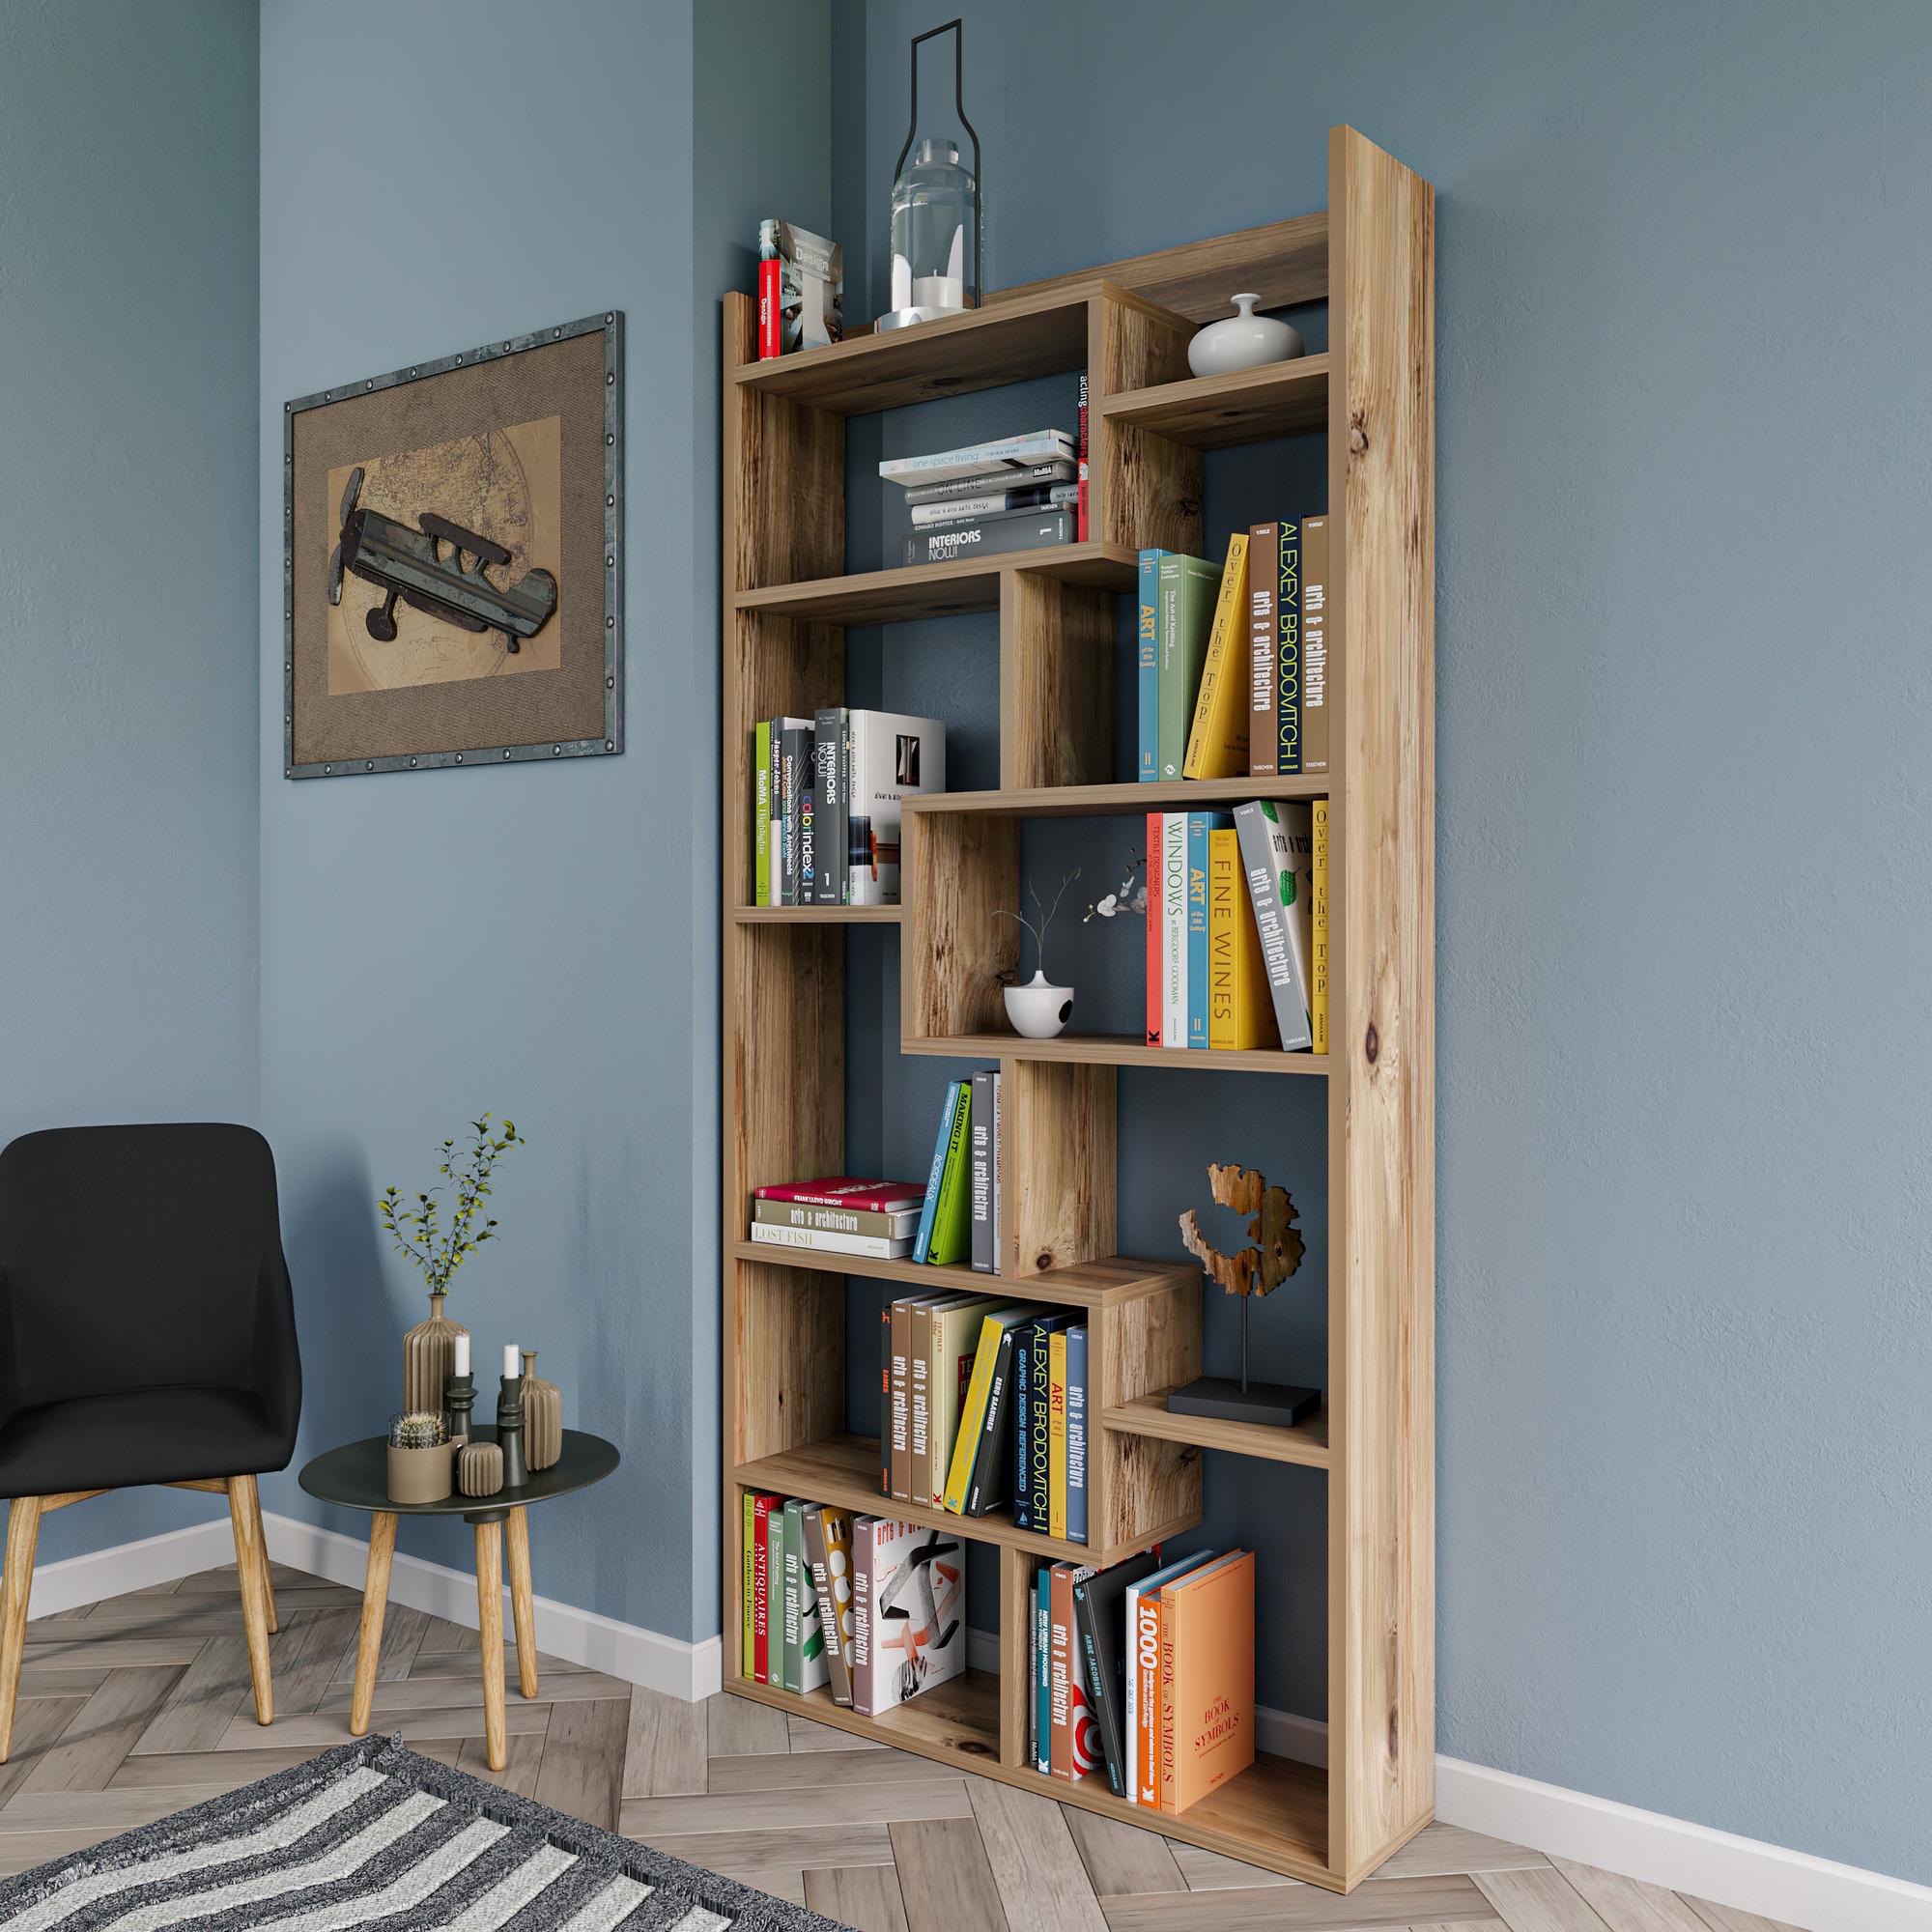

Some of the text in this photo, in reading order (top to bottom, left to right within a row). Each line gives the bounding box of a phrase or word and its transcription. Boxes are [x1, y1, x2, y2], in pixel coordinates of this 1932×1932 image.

[928, 530, 981, 549] INTERIORS
[928, 546, 958, 560] NOW!
[1254, 591, 1273, 615] arts
[1306, 584, 1325, 611] arts
[1141, 605, 1155, 639] ART
[1280, 522, 1298, 758] ALEXEY BRODOVITCH
[1254, 636, 1274, 711] architecture
[1306, 630, 1327, 707] architecture
[818, 742, 827, 778] NOW!
[827, 742, 837, 805] INTERIORS
[1167, 821, 1183, 916] WINDOWS
[1190, 867, 1206, 906] ART
[1214, 861, 1231, 918] FINE
[1250, 867, 1271, 895] arts
[1260, 911, 1291, 986] architecture
[1214, 932, 1231, 1019] WINES
[953, 1093, 968, 1138] MAKING
[974, 1125, 989, 1147] arts
[974, 1161, 990, 1221] architecture
[754, 1226, 813, 1245] LOST FISH
[814, 1210, 858, 1232] architecture
[894, 1355, 907, 1376] arts
[914, 1359, 927, 1379] arts
[1051, 1381, 1063, 1415] ART
[1069, 1385, 1084, 1407] arts
[894, 1391, 908, 1451] architecture
[914, 1394, 928, 1456] architecture
[1033, 1324, 1047, 1521] ALEXEY BRODOVITCH
[1069, 1423, 1086, 1489] architecture
[786, 1553, 799, 1574] arts
[813, 1563, 827, 1582] arts
[856, 1573, 868, 1593] arts
[757, 1544, 766, 1635] ANTIQUAIRES
[786, 1586, 799, 1645] architecture
[819, 1597, 839, 1656] architecture
[855, 1606, 868, 1666] architecture
[1053, 1624, 1068, 1646] arts
[1140, 1606, 1157, 1669] 1000
[1085, 1634, 1103, 1697] ARNE JACOBSEN
[1163, 1642, 1174, 1686] BOOK
[1053, 1661, 1069, 1726] architecture
[1205, 1699, 1231, 1724] BOOK
[1163, 1703, 1174, 1782] SYMBOLS
[1194, 1713, 1239, 1751] SYMBOLS
